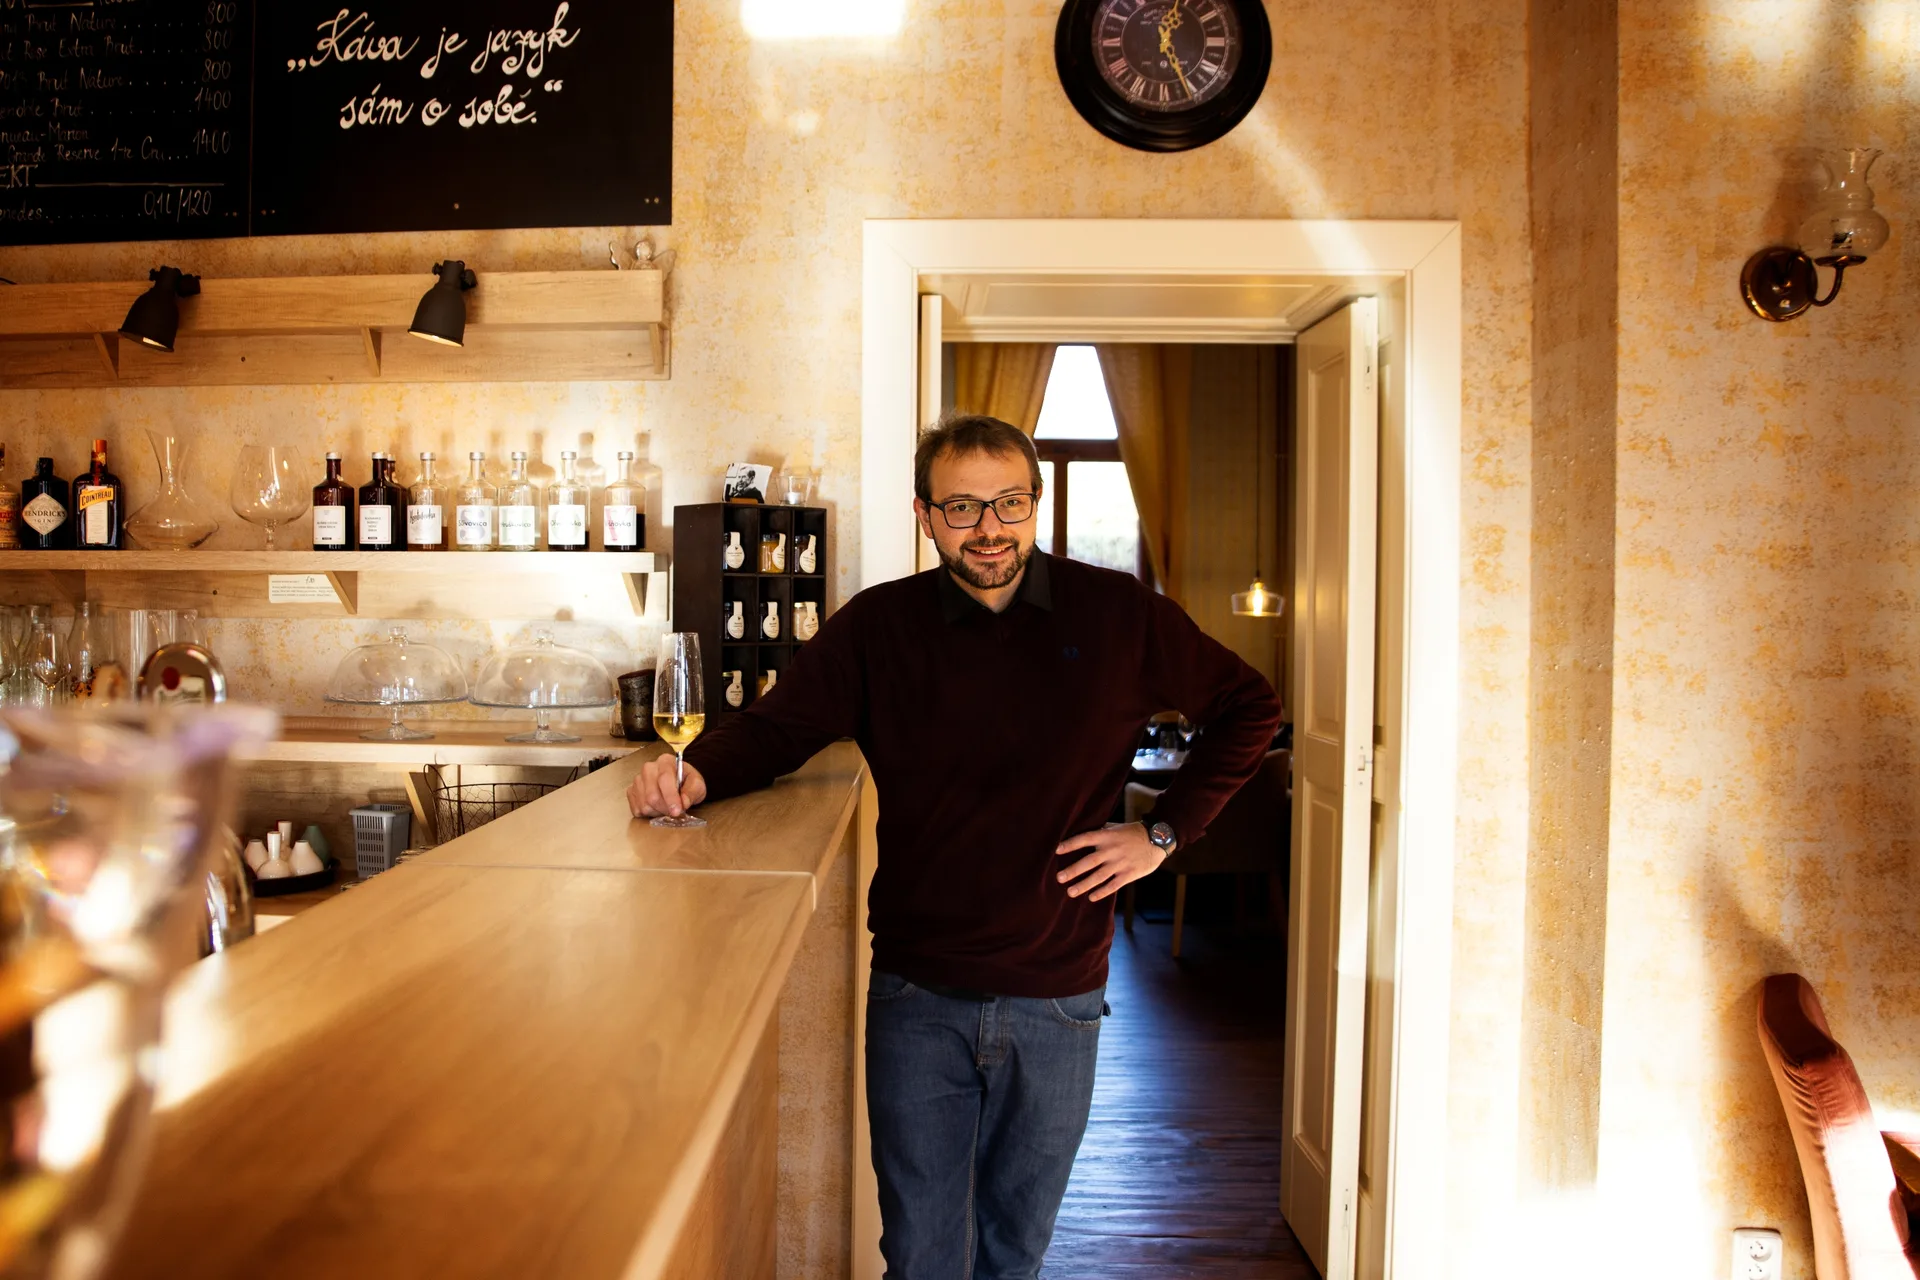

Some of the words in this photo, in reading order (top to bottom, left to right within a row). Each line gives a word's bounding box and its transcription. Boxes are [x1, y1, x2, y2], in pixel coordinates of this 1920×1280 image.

[420, 26, 468, 79] je
[470, 1, 581, 78] jazyk
[203, 59, 232, 83] 800
[194, 87, 232, 111] 1400
[339, 83, 415, 129] sám
[421, 97, 452, 127] o
[193, 128, 232, 155] 1400
[81, 490, 112, 506] COINTREAU
